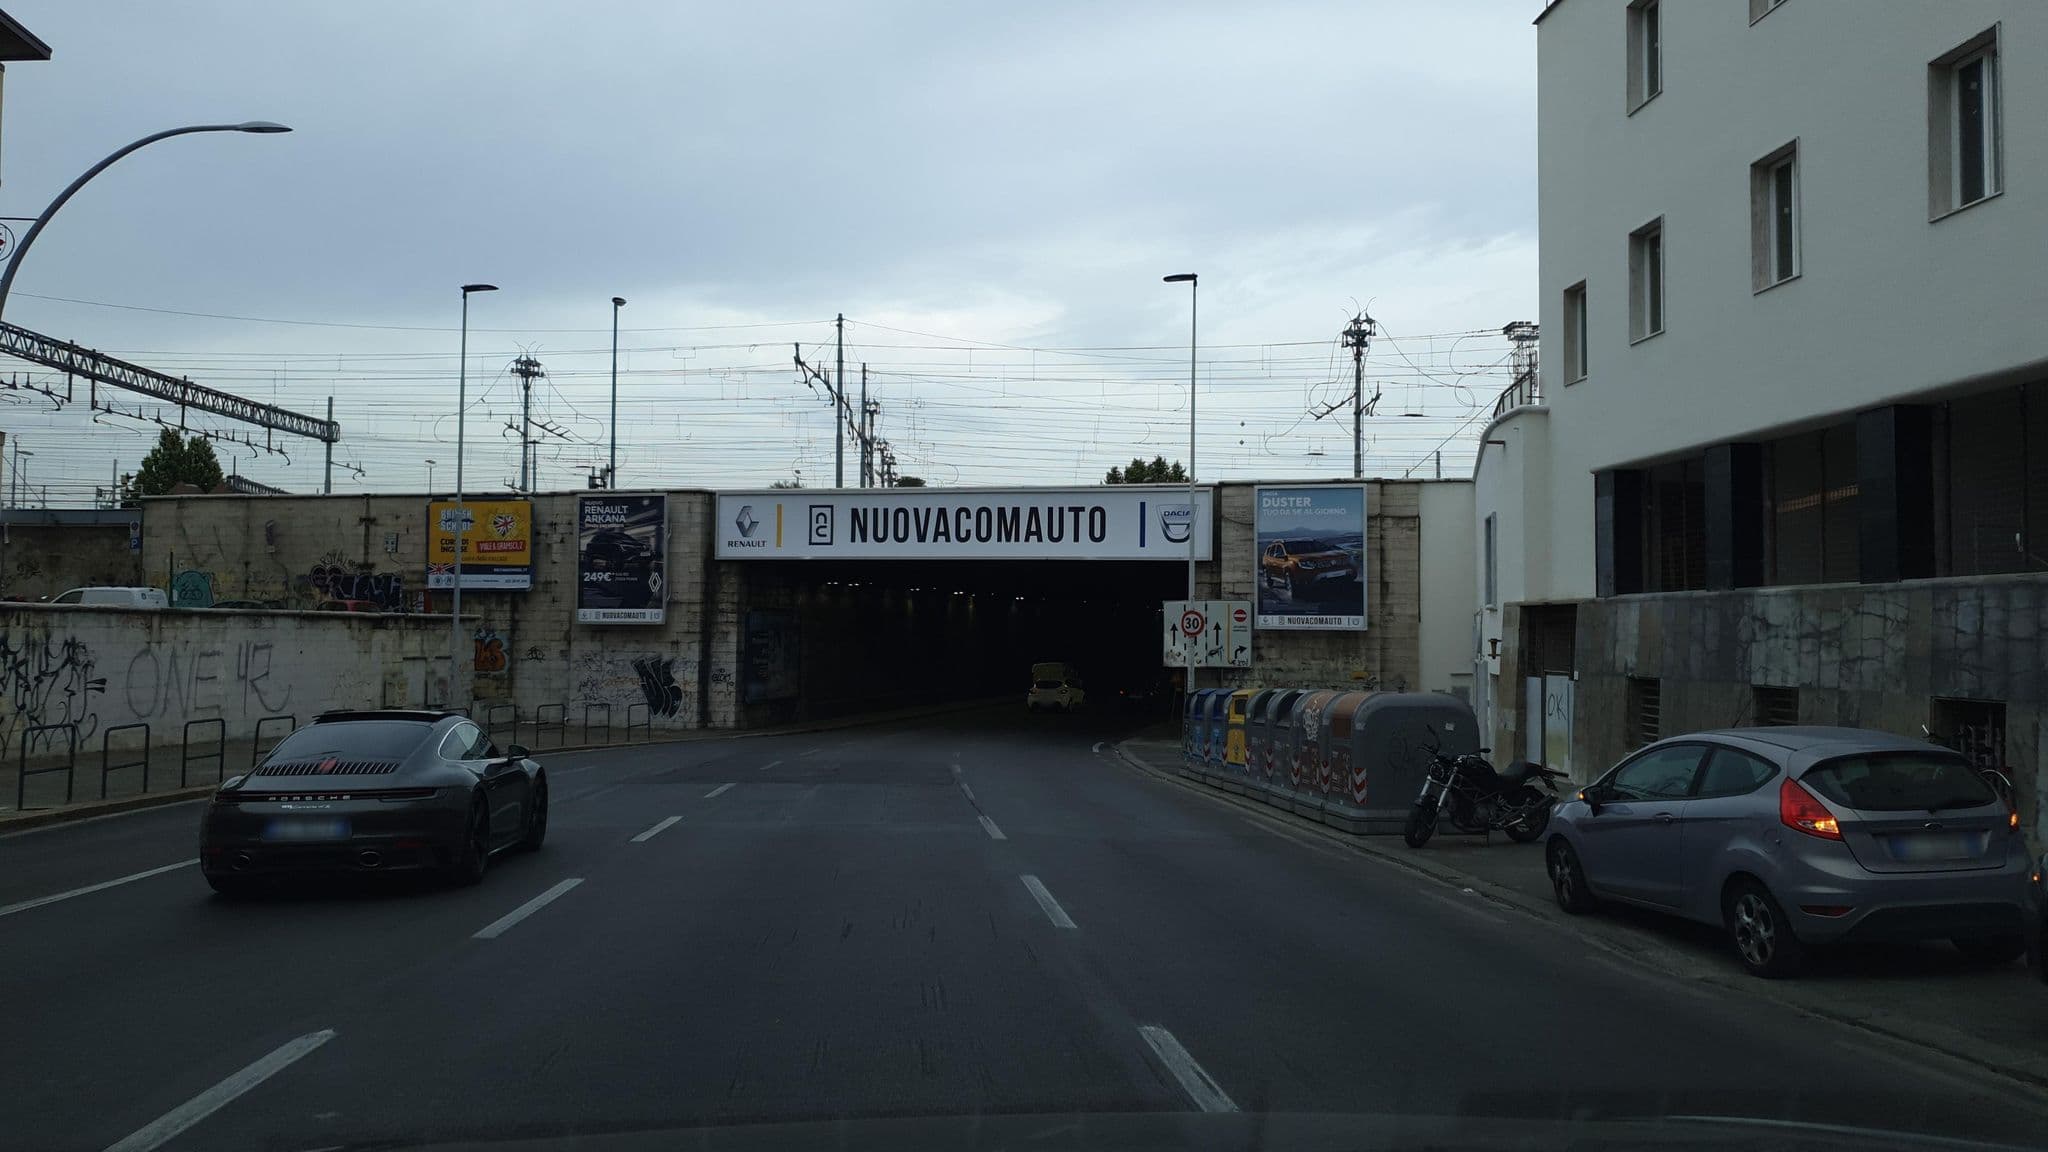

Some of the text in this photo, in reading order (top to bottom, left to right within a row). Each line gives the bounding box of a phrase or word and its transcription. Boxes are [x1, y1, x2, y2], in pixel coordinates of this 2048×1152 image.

[1262, 497, 1312, 507] DUSTER
[584, 505, 629, 514] RENAULT
[584, 514, 626, 523] ARKANA
[850, 506, 1106, 544] NUOVACOMAUTO
[728, 540, 767, 549] RENAULT
[1184, 617, 1200, 630] 30
[1287, 617, 1342, 626] NUOVACOMAUTO
[1547, 693, 1567, 721] OK
